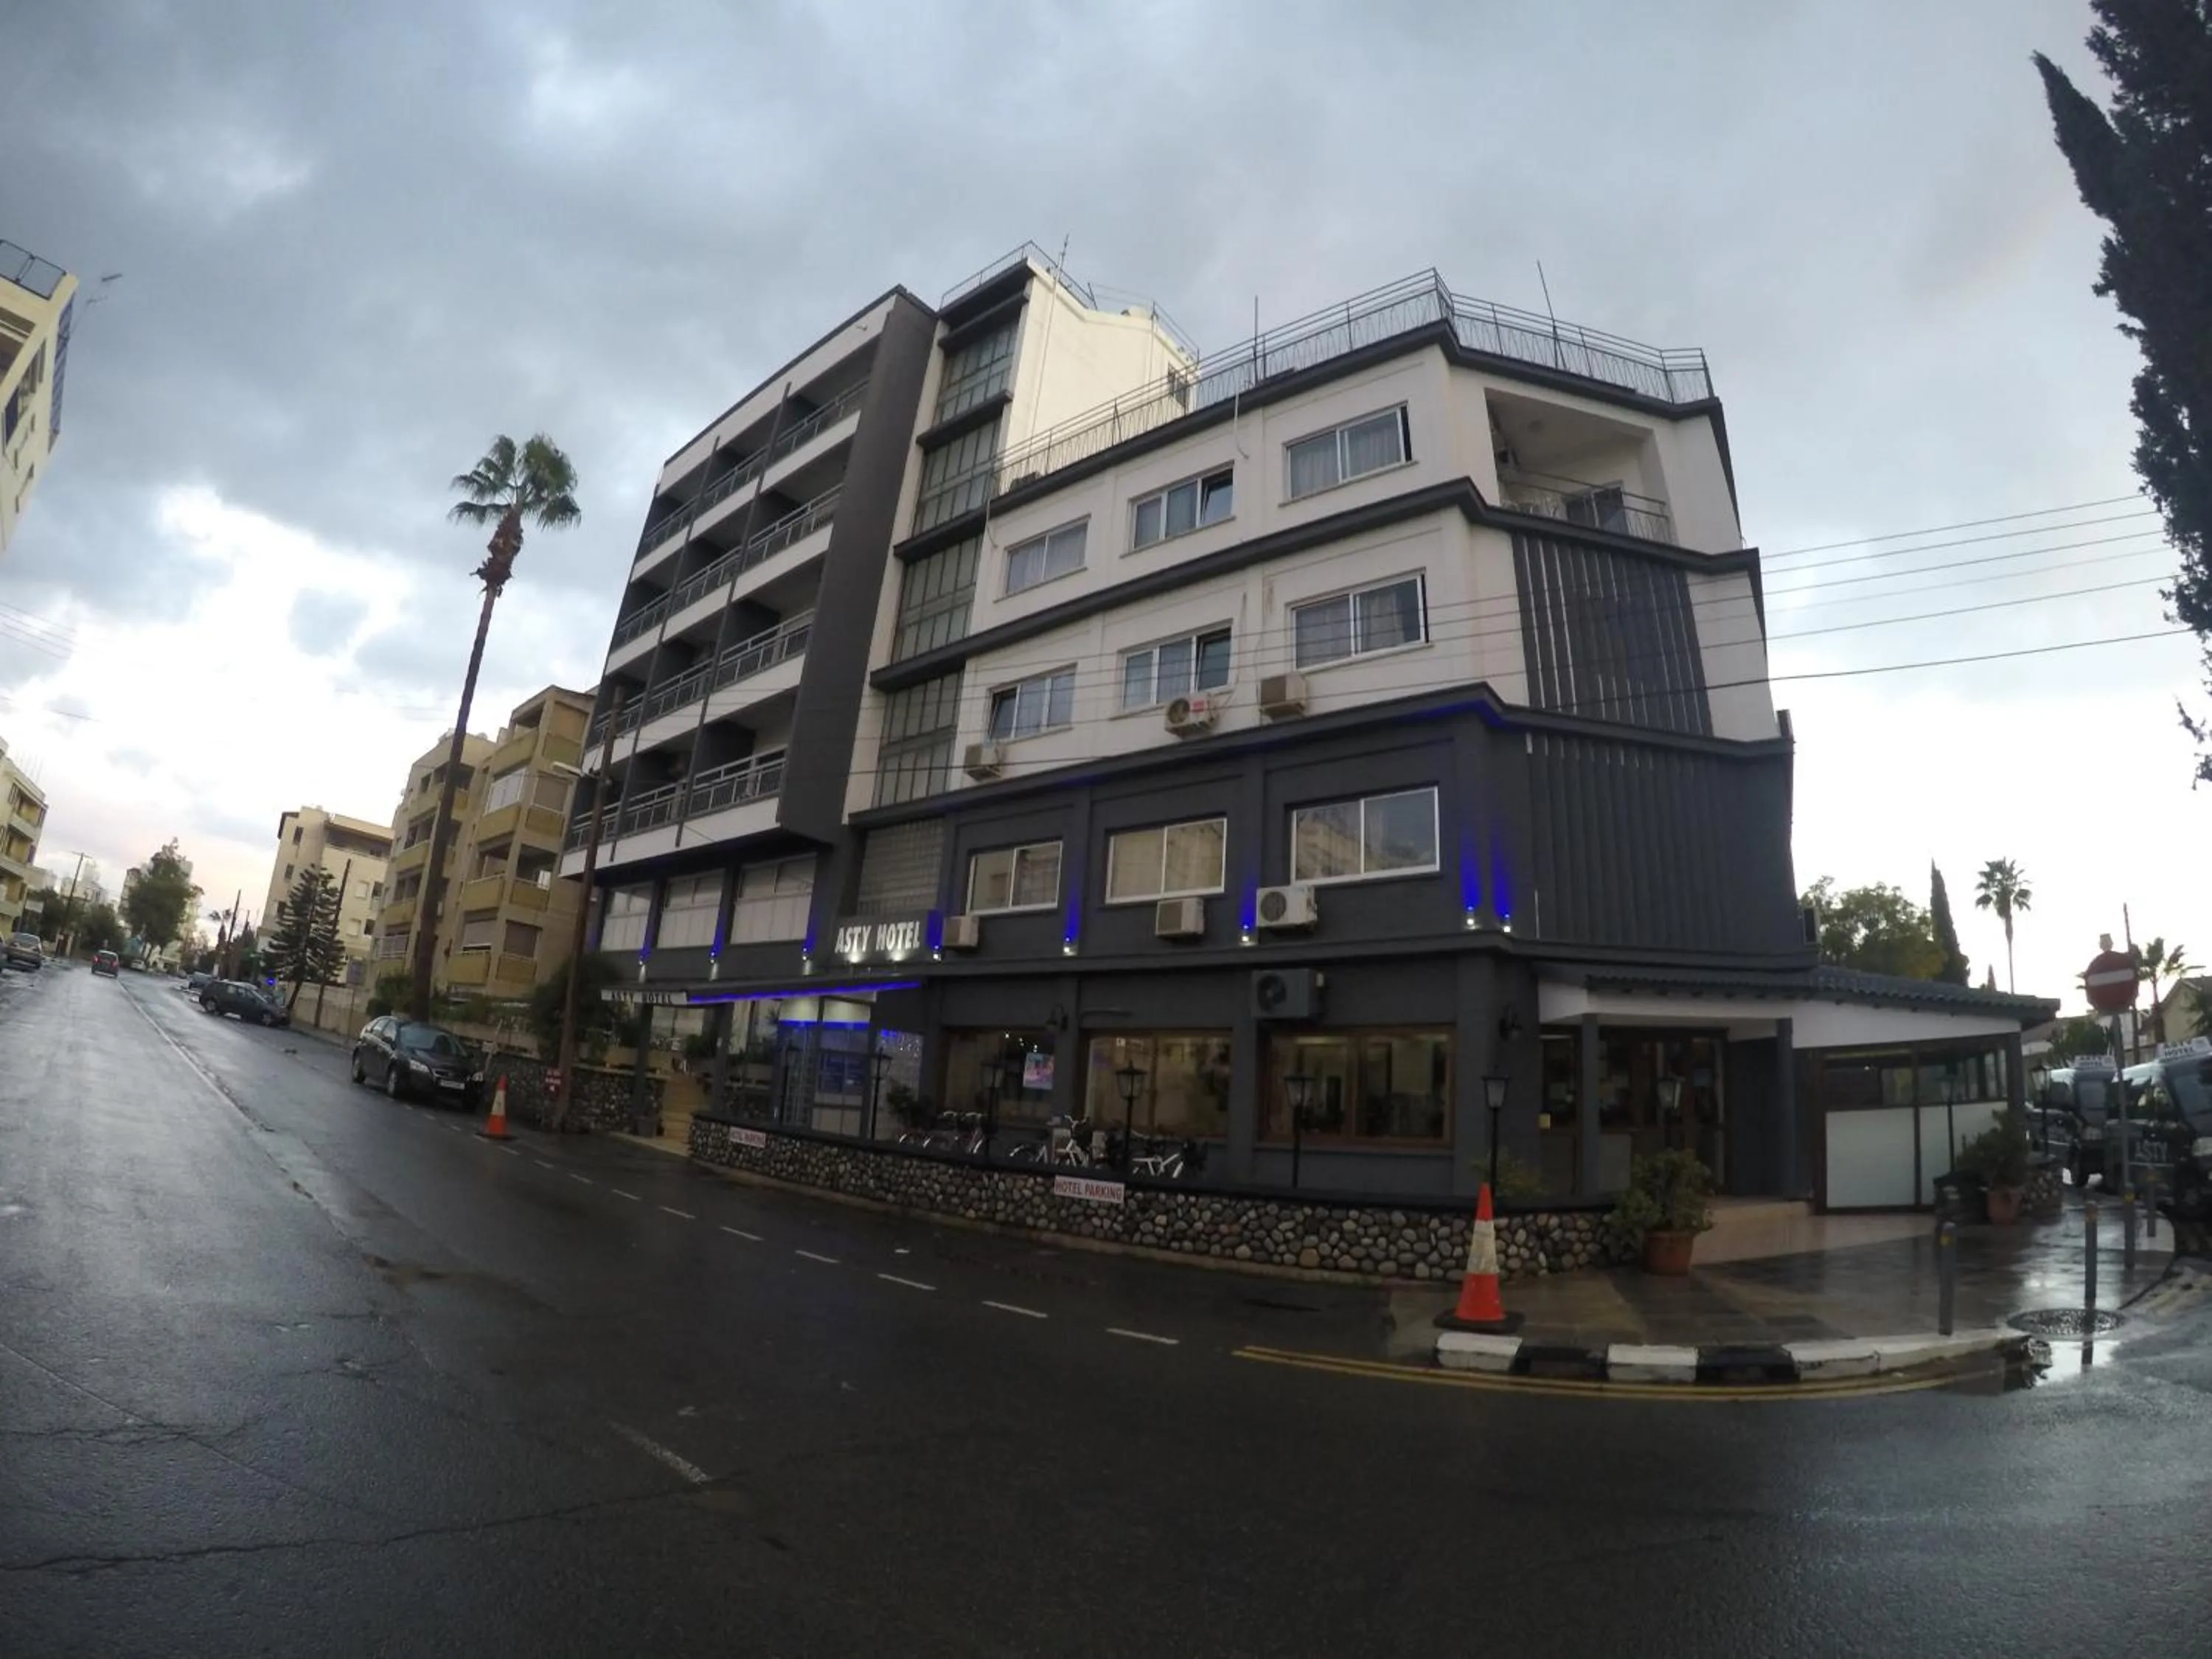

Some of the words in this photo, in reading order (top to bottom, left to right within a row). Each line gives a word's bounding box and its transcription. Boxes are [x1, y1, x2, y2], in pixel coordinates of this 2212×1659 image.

[835, 925, 872, 953] ASTY
[875, 921, 921, 951] HOTEL
[2164, 1046, 2194, 1057] HOTEL
[1055, 1179, 1082, 1194] HOTEL
[1085, 1182, 1122, 1202] PARKING
